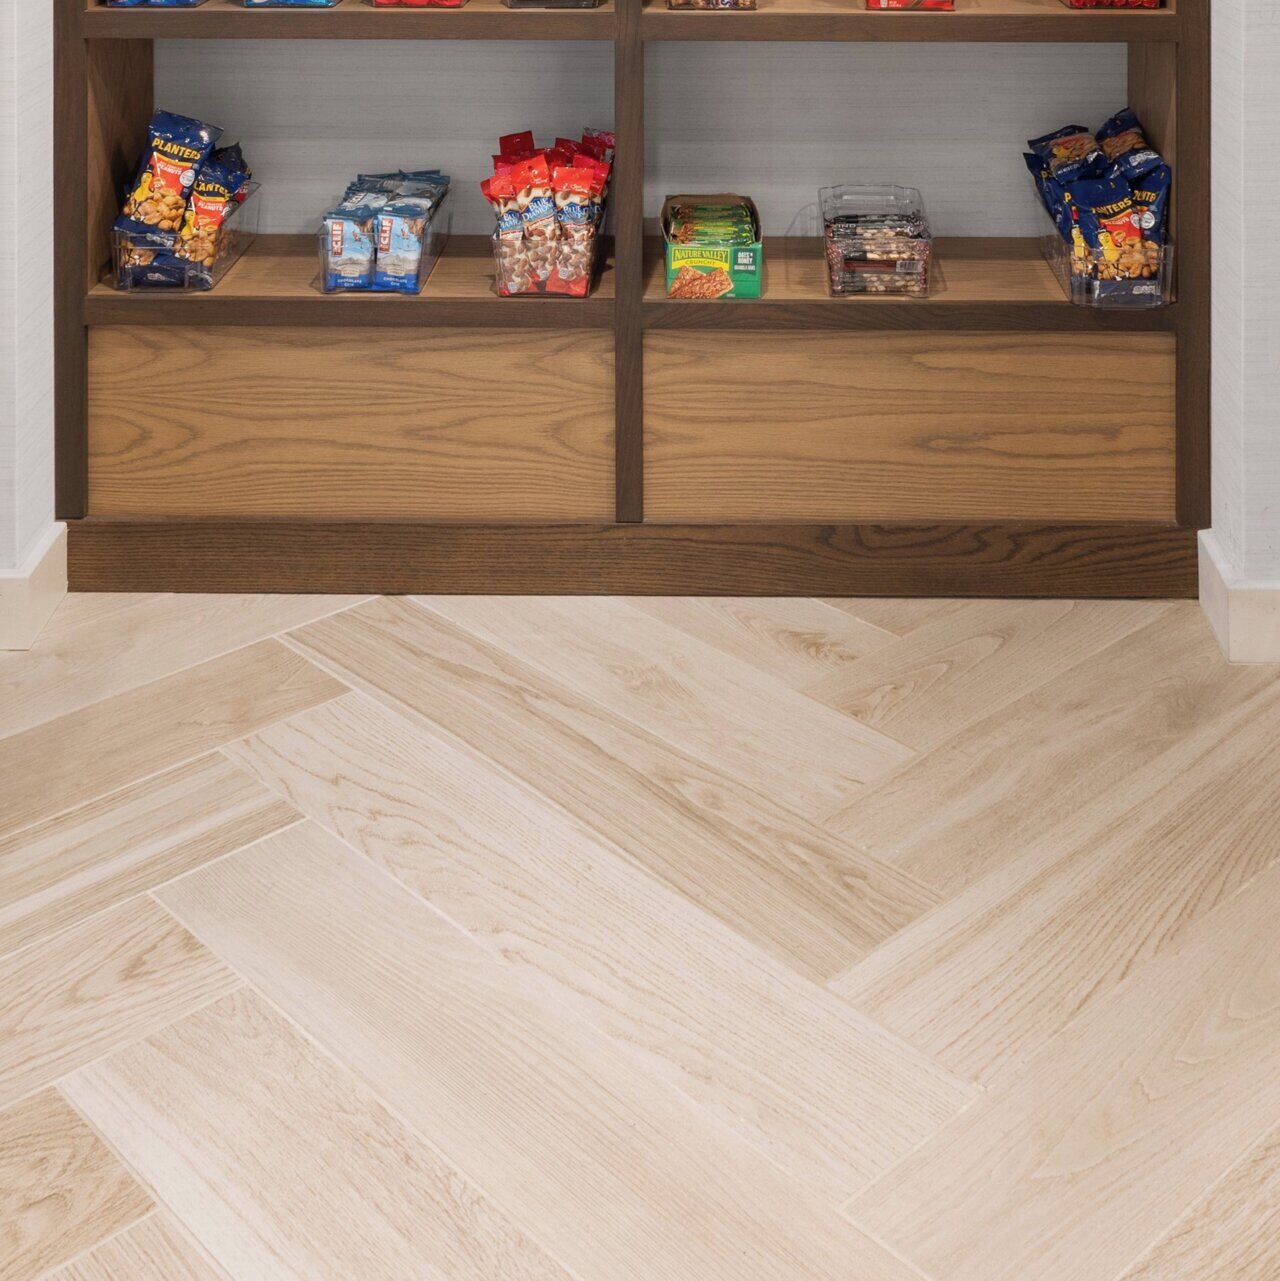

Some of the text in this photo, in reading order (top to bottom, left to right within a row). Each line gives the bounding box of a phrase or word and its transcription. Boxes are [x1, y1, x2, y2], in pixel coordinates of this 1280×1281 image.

[151, 137, 202, 161] PLANTERS
[529, 197, 548, 213] BLUE
[563, 204, 583, 214] BLUE
[673, 248, 729, 262] NATURE VALLEY
